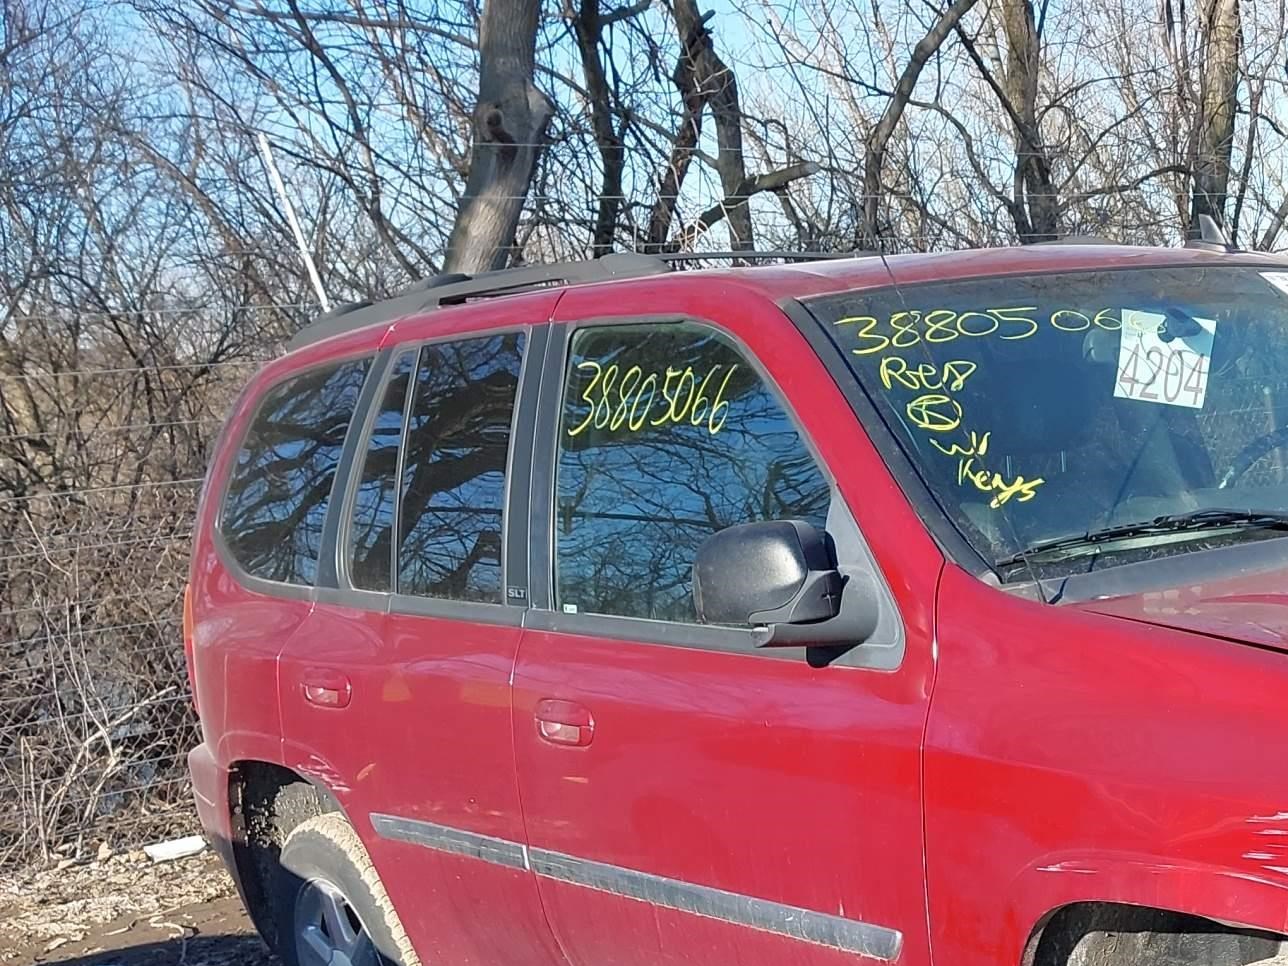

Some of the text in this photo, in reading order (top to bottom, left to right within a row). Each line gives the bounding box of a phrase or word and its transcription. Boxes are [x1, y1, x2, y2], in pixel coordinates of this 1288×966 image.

[568, 361, 739, 436] 38805066
[1119, 343, 1203, 406] 4204
[958, 459, 1045, 508] Keys
[508, 588, 525, 598] SLT
